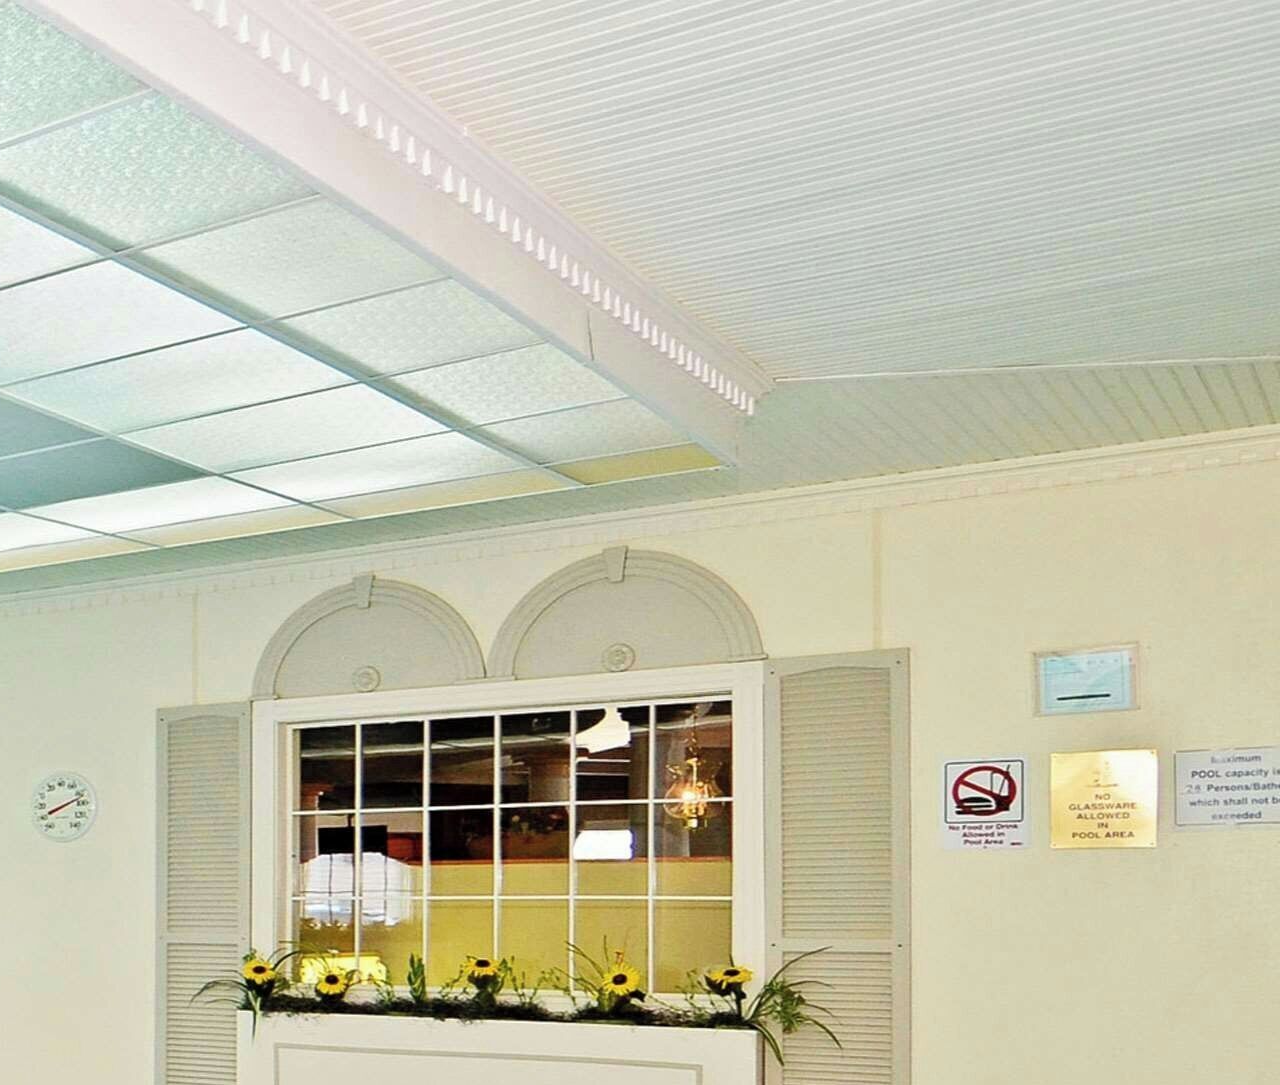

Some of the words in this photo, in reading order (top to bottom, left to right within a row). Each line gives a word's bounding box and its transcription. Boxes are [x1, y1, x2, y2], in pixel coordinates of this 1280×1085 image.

[1191, 770, 1221, 778] POOL
[1225, 768, 1269, 778] capacity
[1189, 798, 1219, 806] which
[1224, 797, 1248, 806] shall
[1251, 797, 1268, 805] not
[1068, 802, 1137, 811] GLASSWARE
[1076, 811, 1130, 820] ALLOWED
[1211, 811, 1262, 820] exceeded
[1071, 831, 1101, 839] POOL
